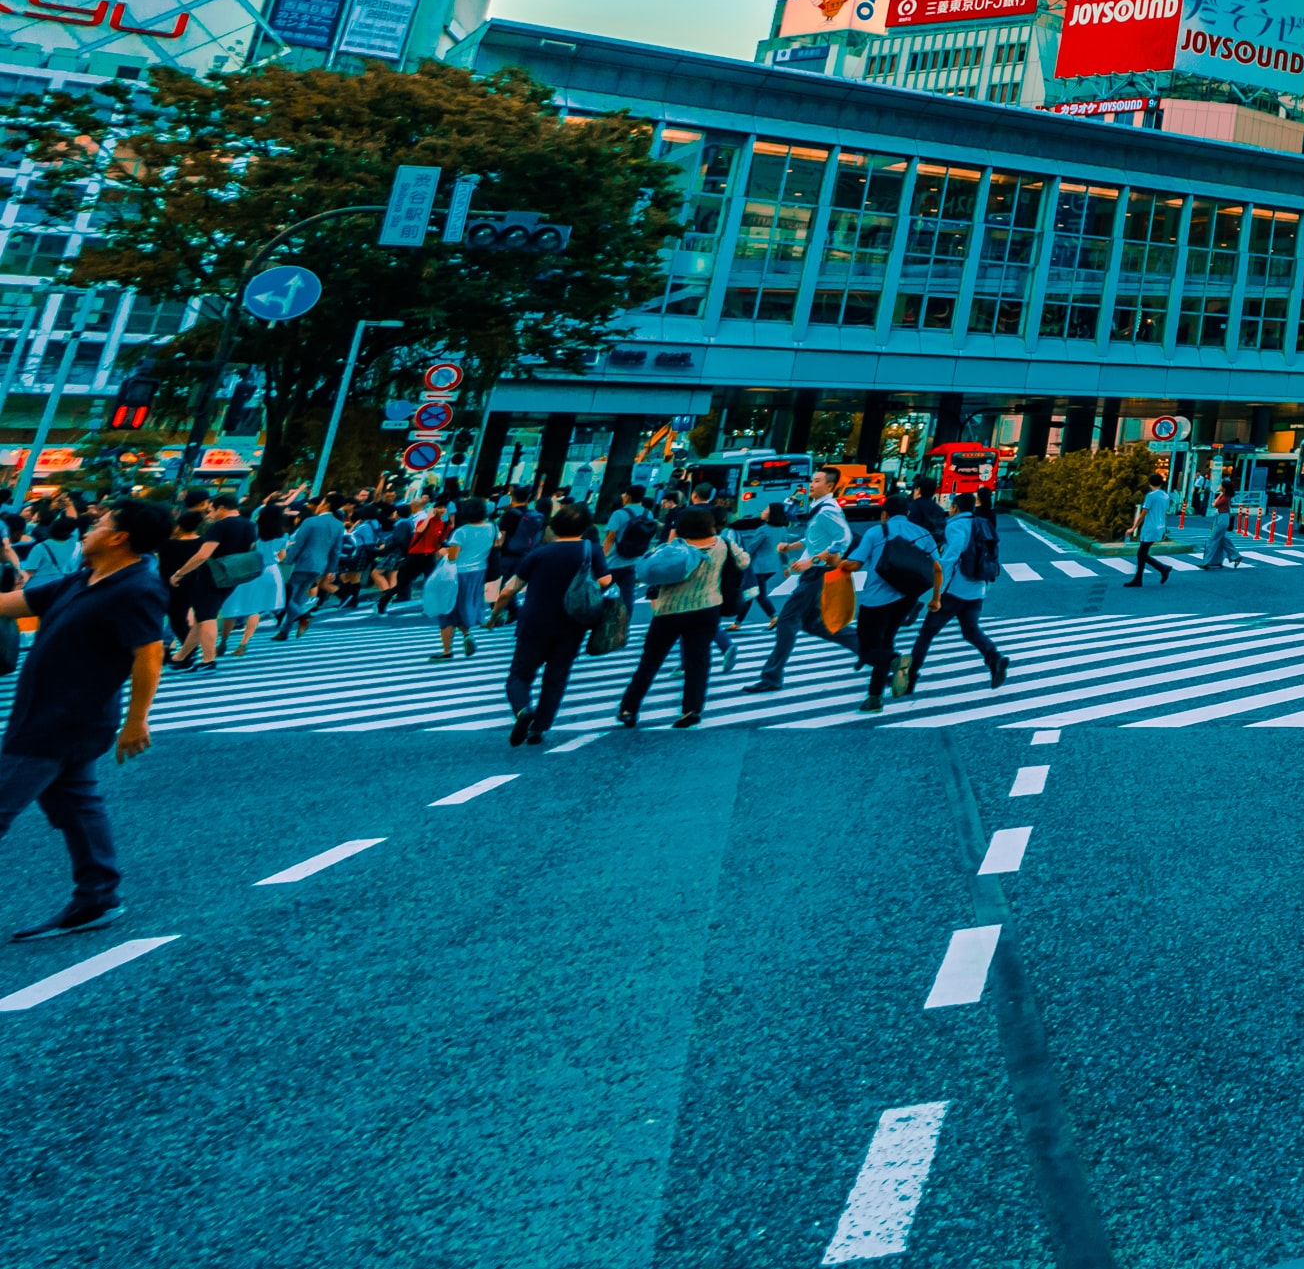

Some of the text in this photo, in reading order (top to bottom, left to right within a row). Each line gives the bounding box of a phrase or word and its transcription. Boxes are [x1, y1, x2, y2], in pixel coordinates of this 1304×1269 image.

[1181, 29, 1304, 75] JOYSOUND
[1060, 104, 1096, 115] カラオケ
[1098, 100, 1143, 113] JOYSOUND
